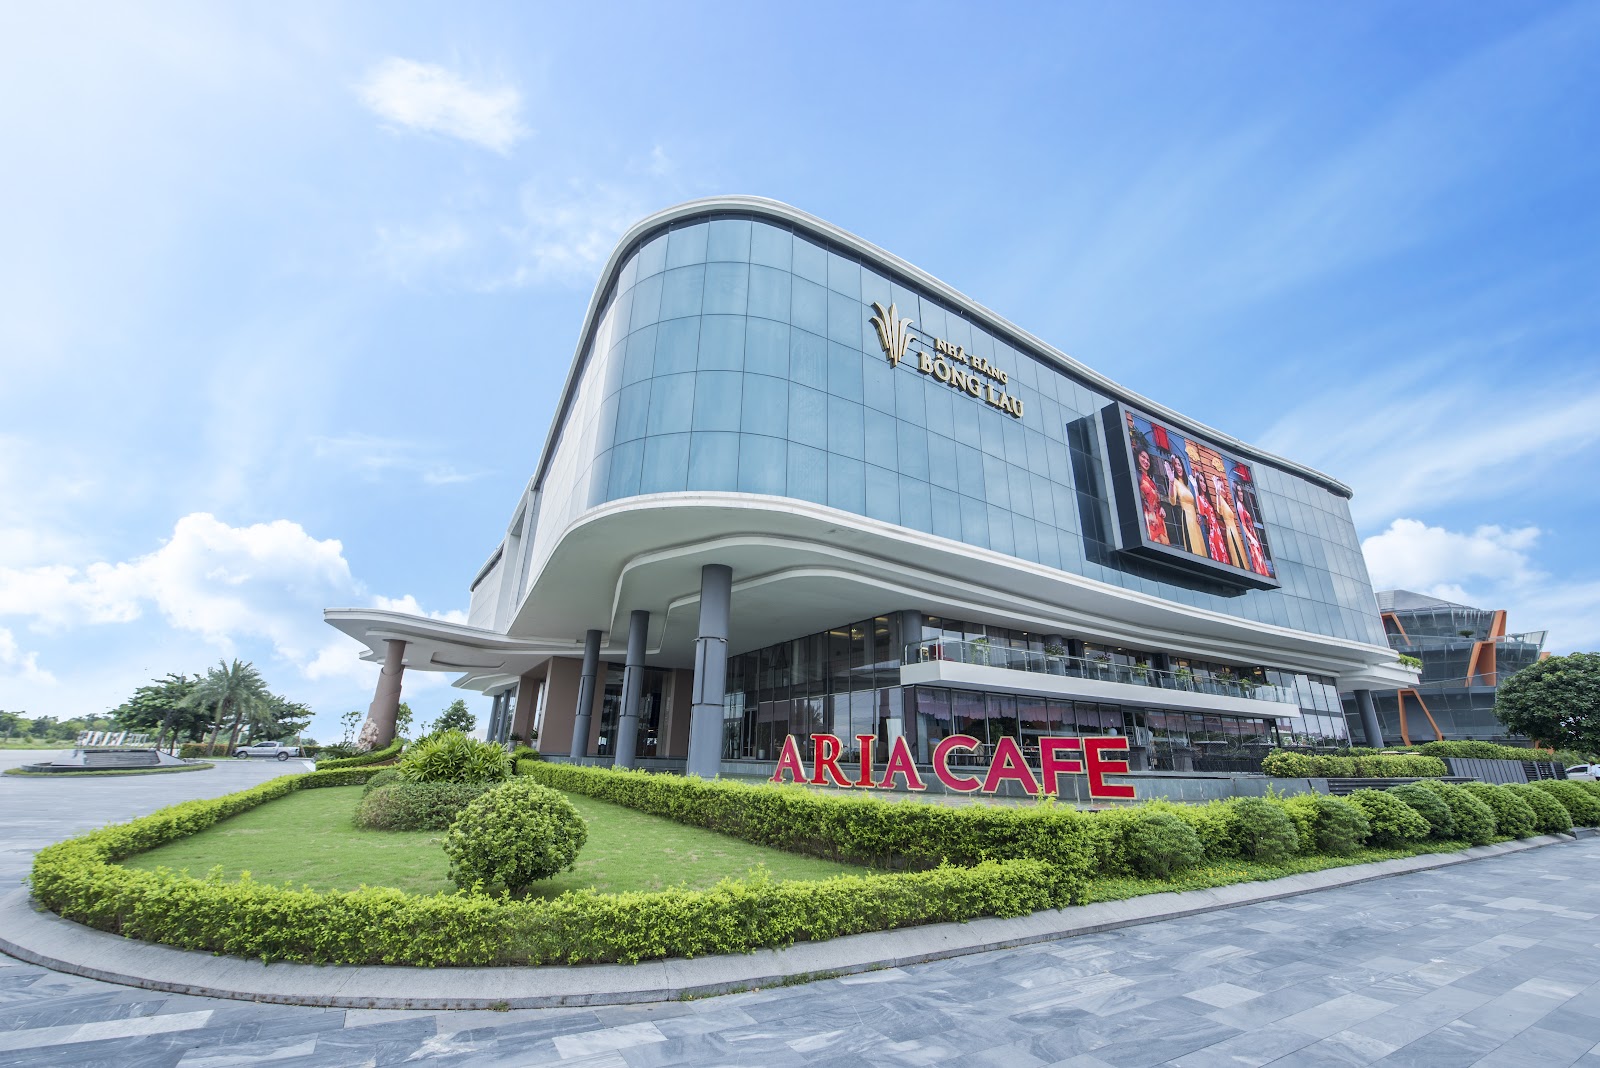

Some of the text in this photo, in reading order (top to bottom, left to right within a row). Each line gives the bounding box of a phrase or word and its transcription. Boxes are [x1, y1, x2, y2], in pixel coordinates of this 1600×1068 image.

[918, 351, 1025, 418] BÔNG LAU
[769, 733, 1136, 799] ARIA CAFE
